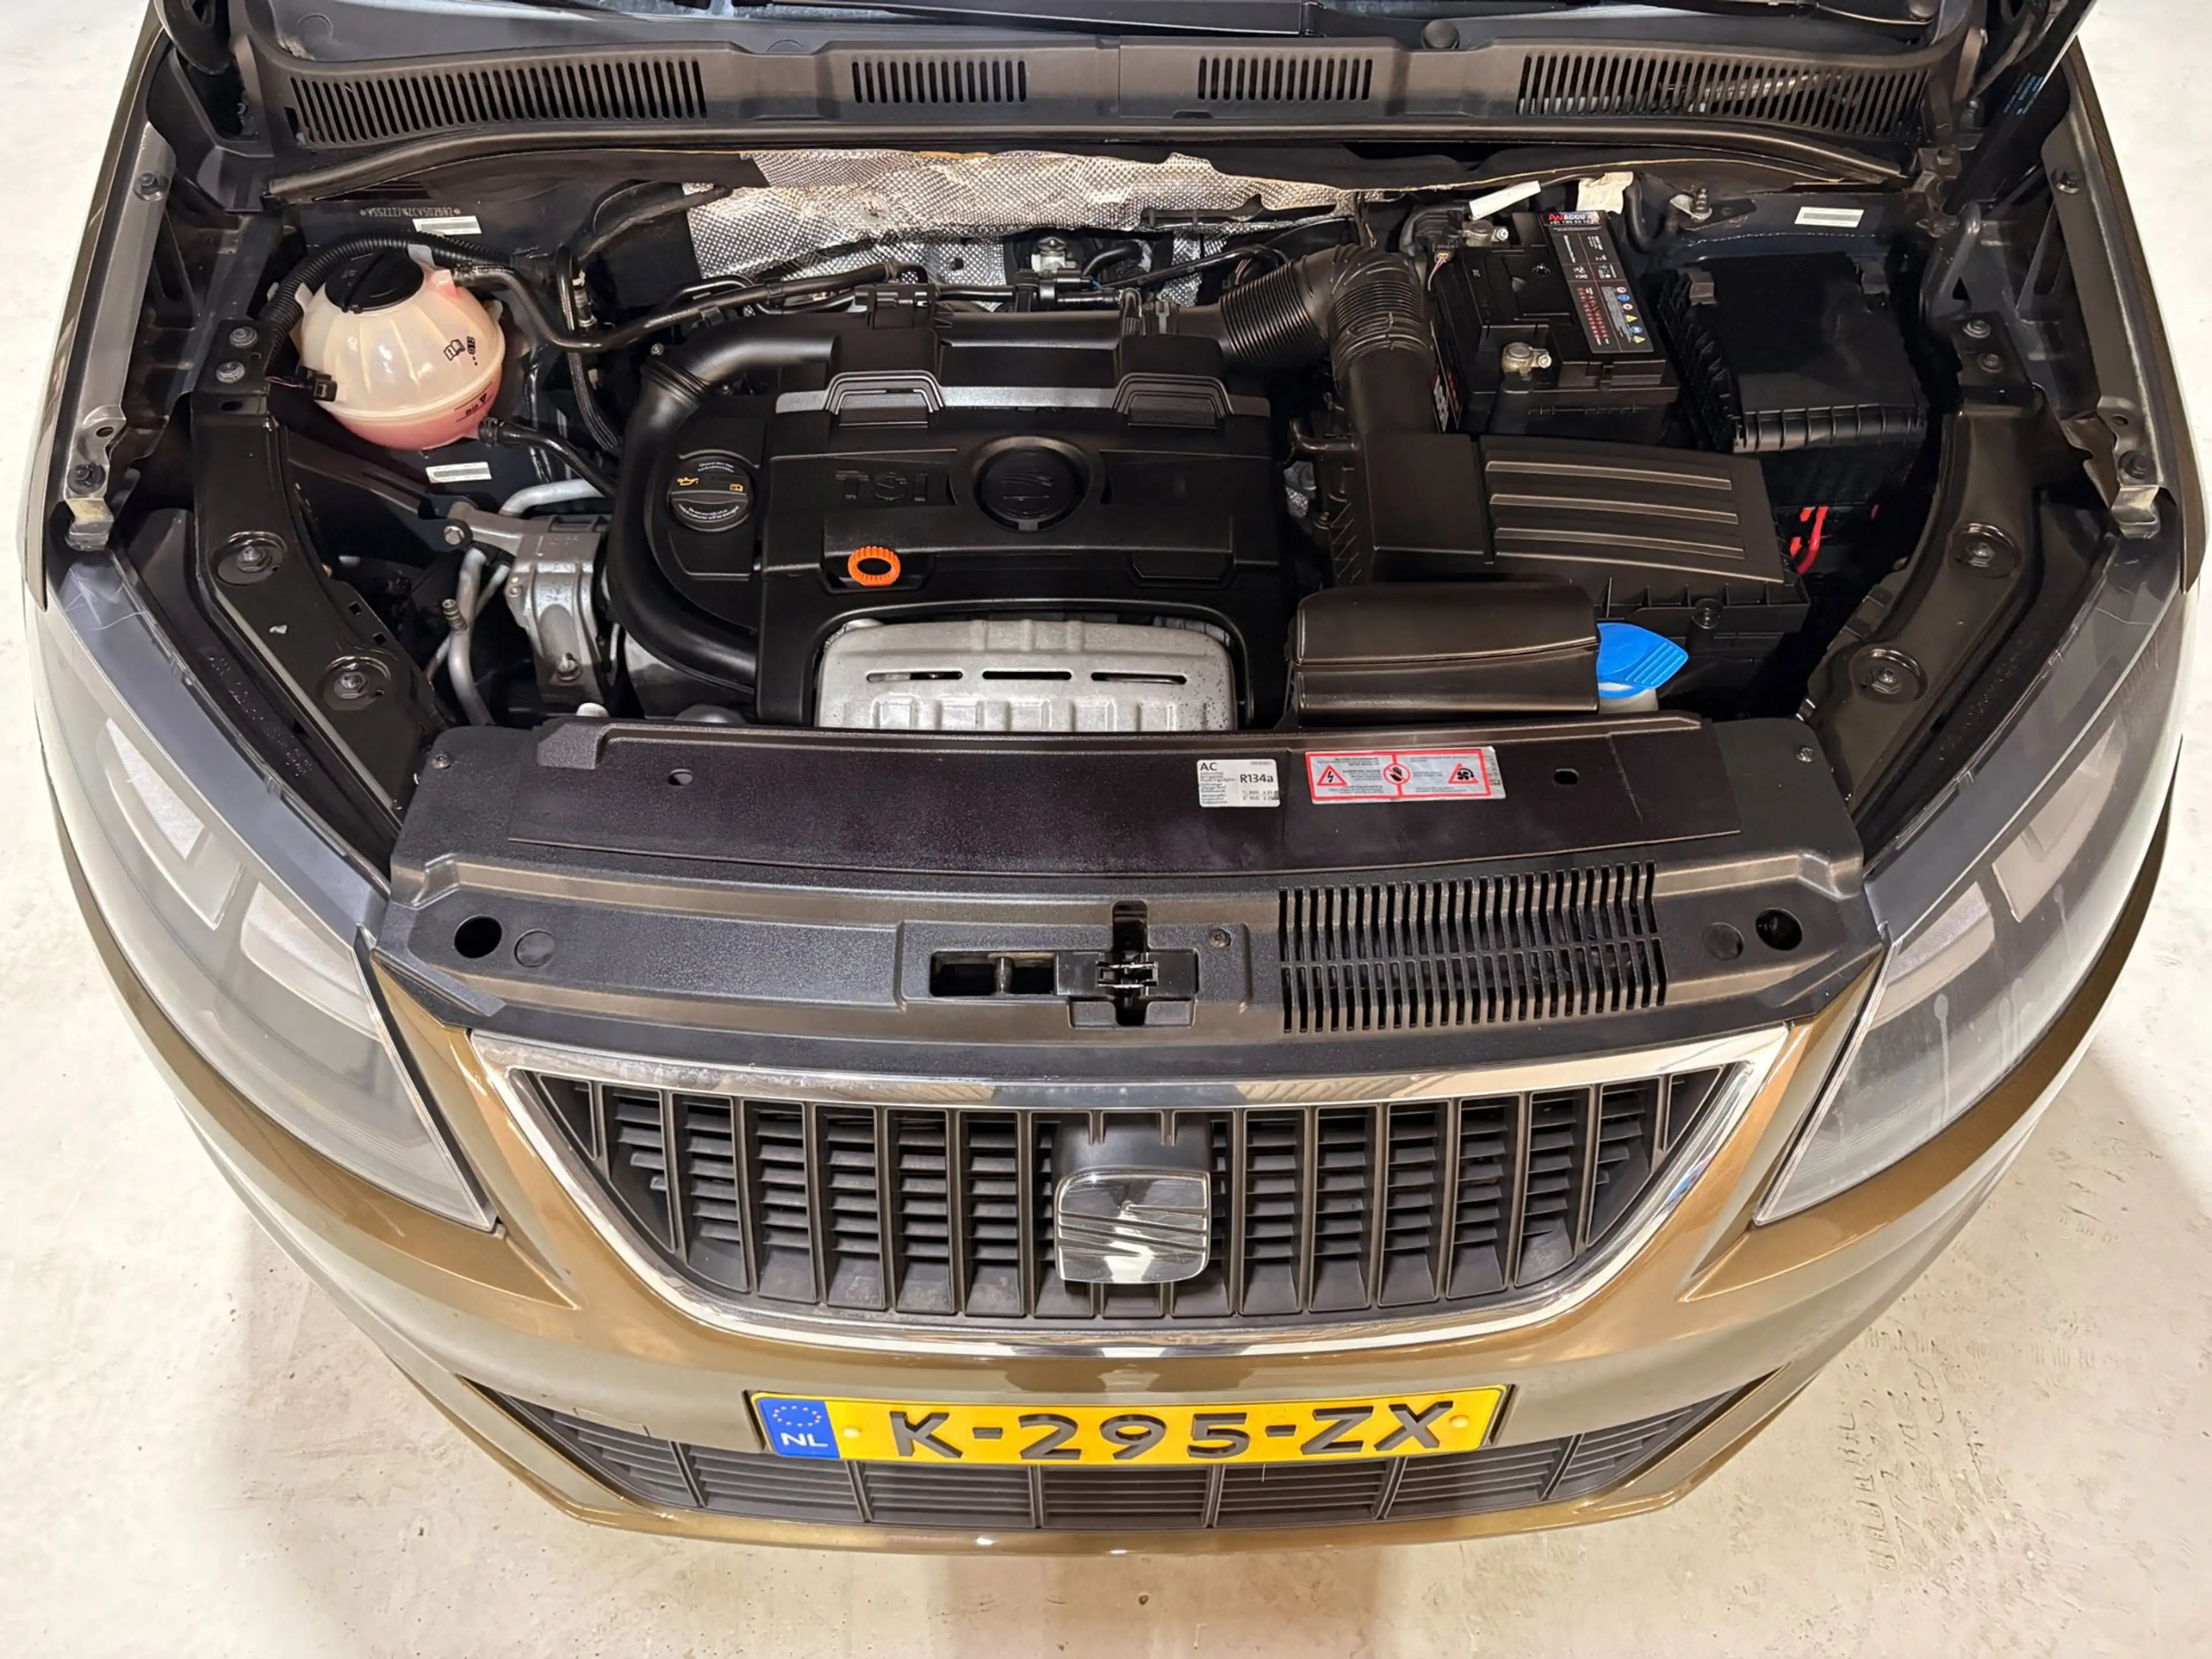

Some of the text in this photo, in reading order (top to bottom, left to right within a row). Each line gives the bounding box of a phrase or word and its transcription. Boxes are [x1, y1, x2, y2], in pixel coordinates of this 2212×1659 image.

[835, 469, 929, 502] TSI
[1200, 762, 1217, 771] AC
[1240, 774, 1274, 783] R134a
[889, 1401, 1453, 1460] K-295-ZX
[781, 1431, 828, 1448] NL
